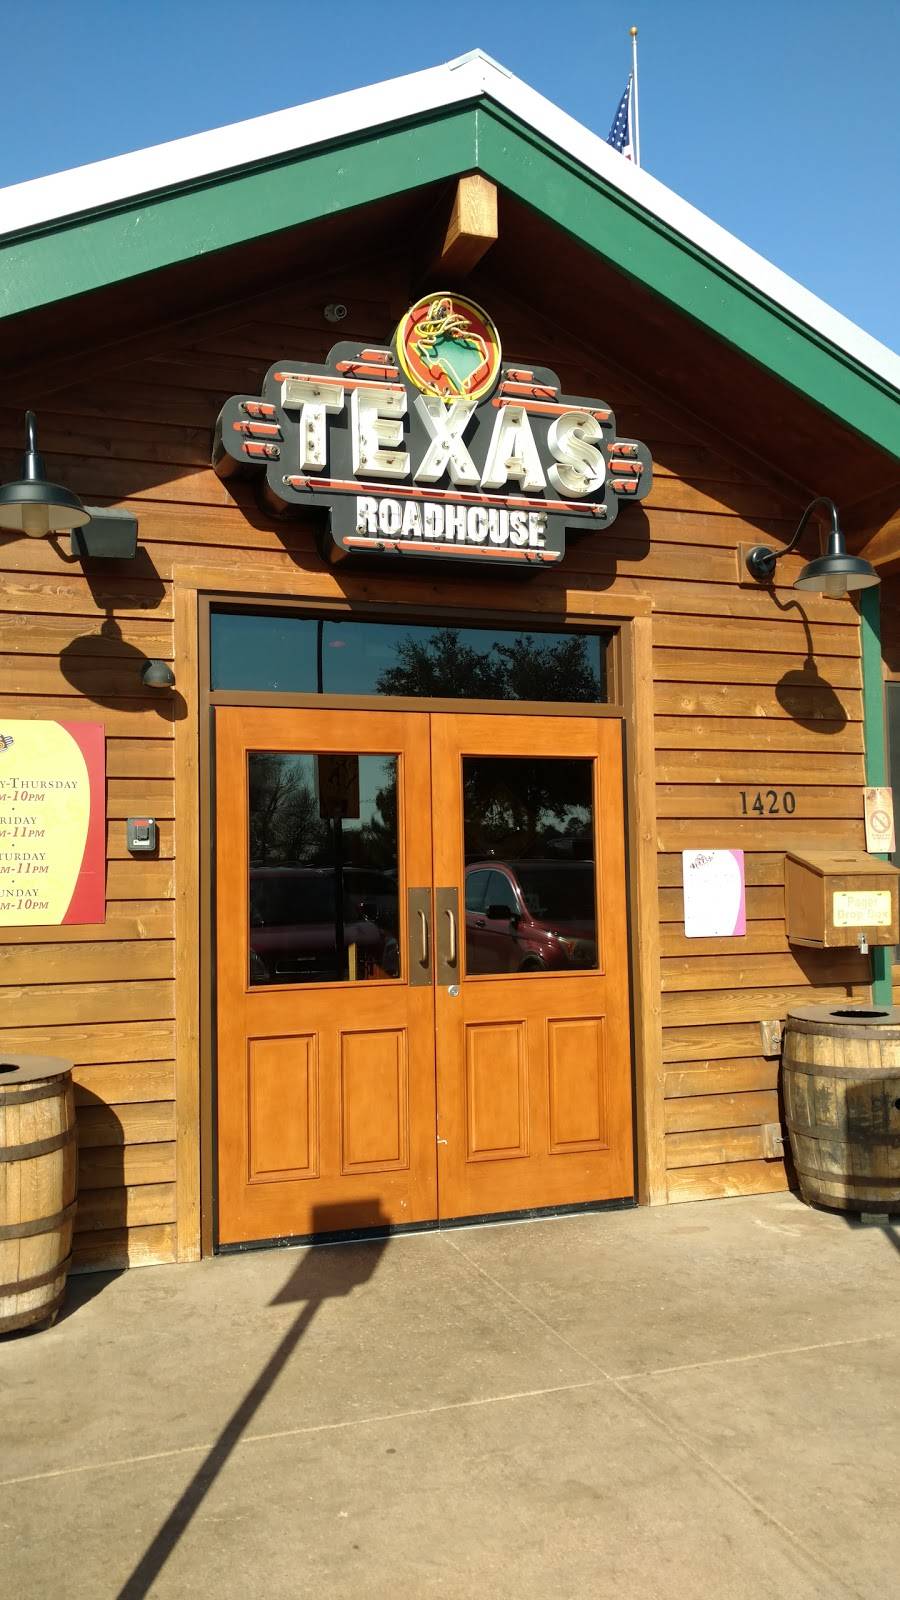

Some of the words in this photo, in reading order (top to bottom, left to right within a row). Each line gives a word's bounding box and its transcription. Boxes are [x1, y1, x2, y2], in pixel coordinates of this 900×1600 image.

[281, 378, 607, 498] TEXAS
[356, 496, 547, 547] ROADHOUSE
[739, 790, 796, 815] 1420
